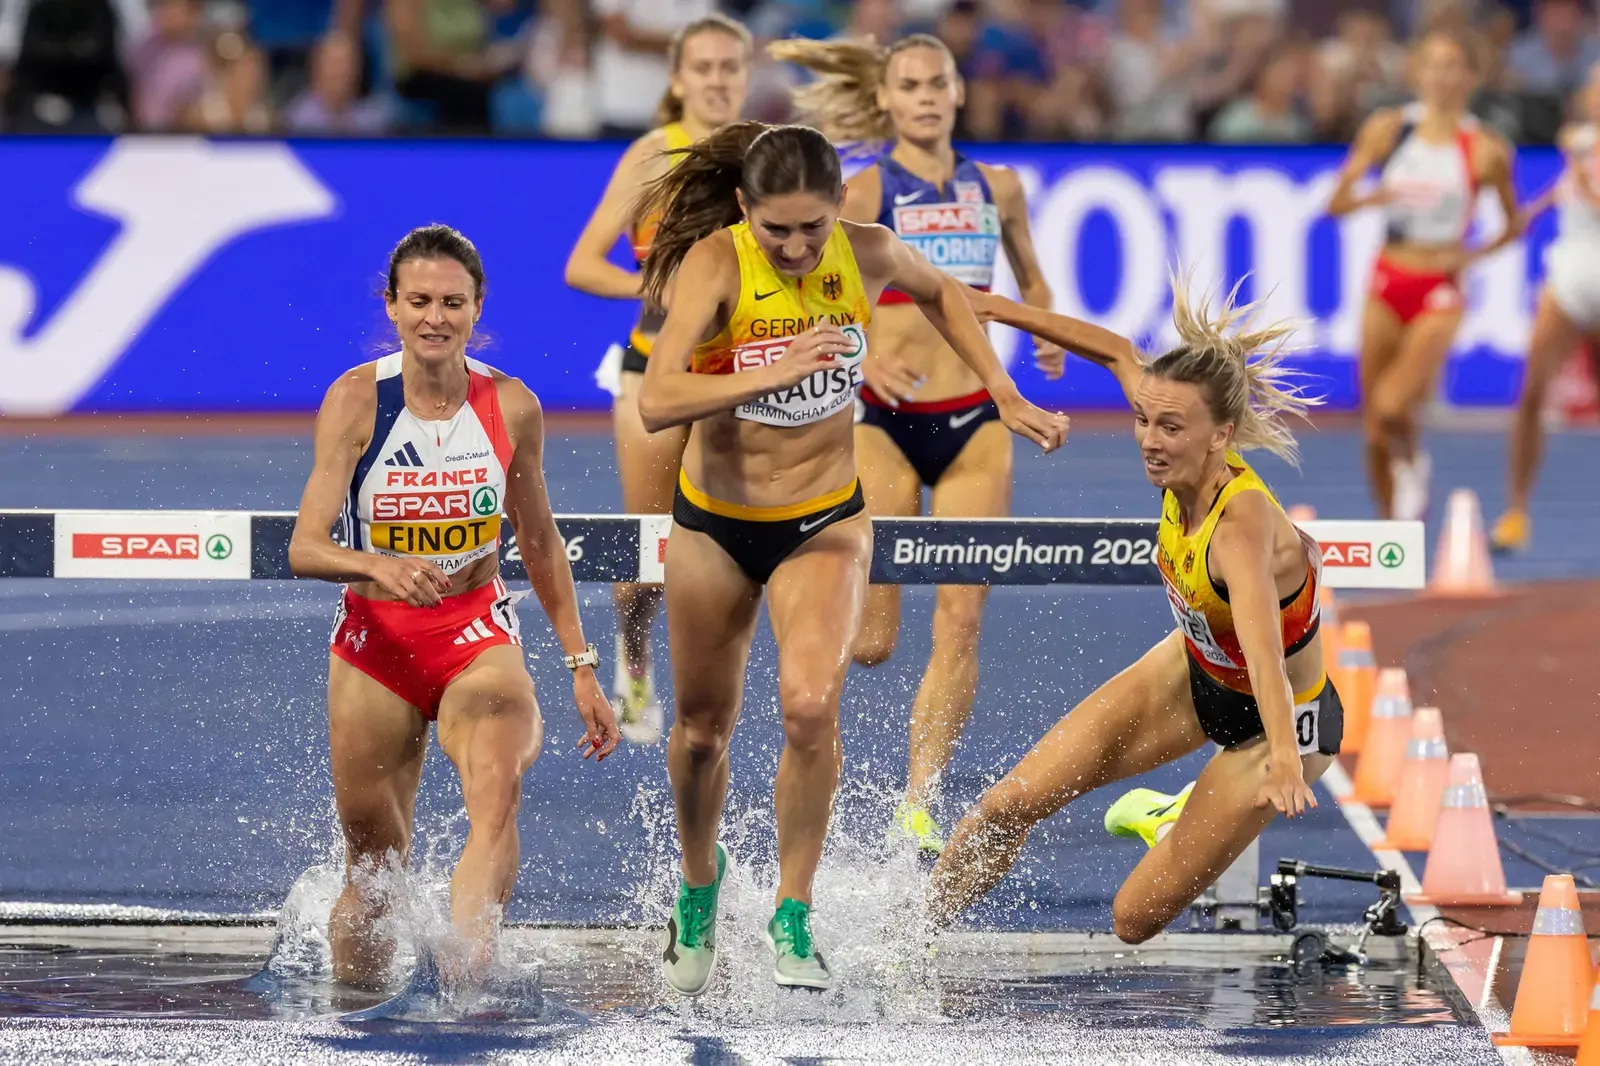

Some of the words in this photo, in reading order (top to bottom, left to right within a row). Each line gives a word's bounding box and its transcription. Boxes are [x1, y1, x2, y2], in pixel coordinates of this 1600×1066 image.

[900, 209, 977, 231] SPAR
[750, 312, 856, 338] GERMNY
[742, 403, 829, 421] BIRMINGHAM
[386, 468, 488, 487] FRANCE
[375, 494, 468, 518] SPAR
[101, 537, 197, 555] SPAR
[388, 521, 487, 552] FINOT
[893, 536, 1085, 573] Birmingham
[1090, 538, 1159, 565] 202
[1321, 547, 1370, 564] AR
